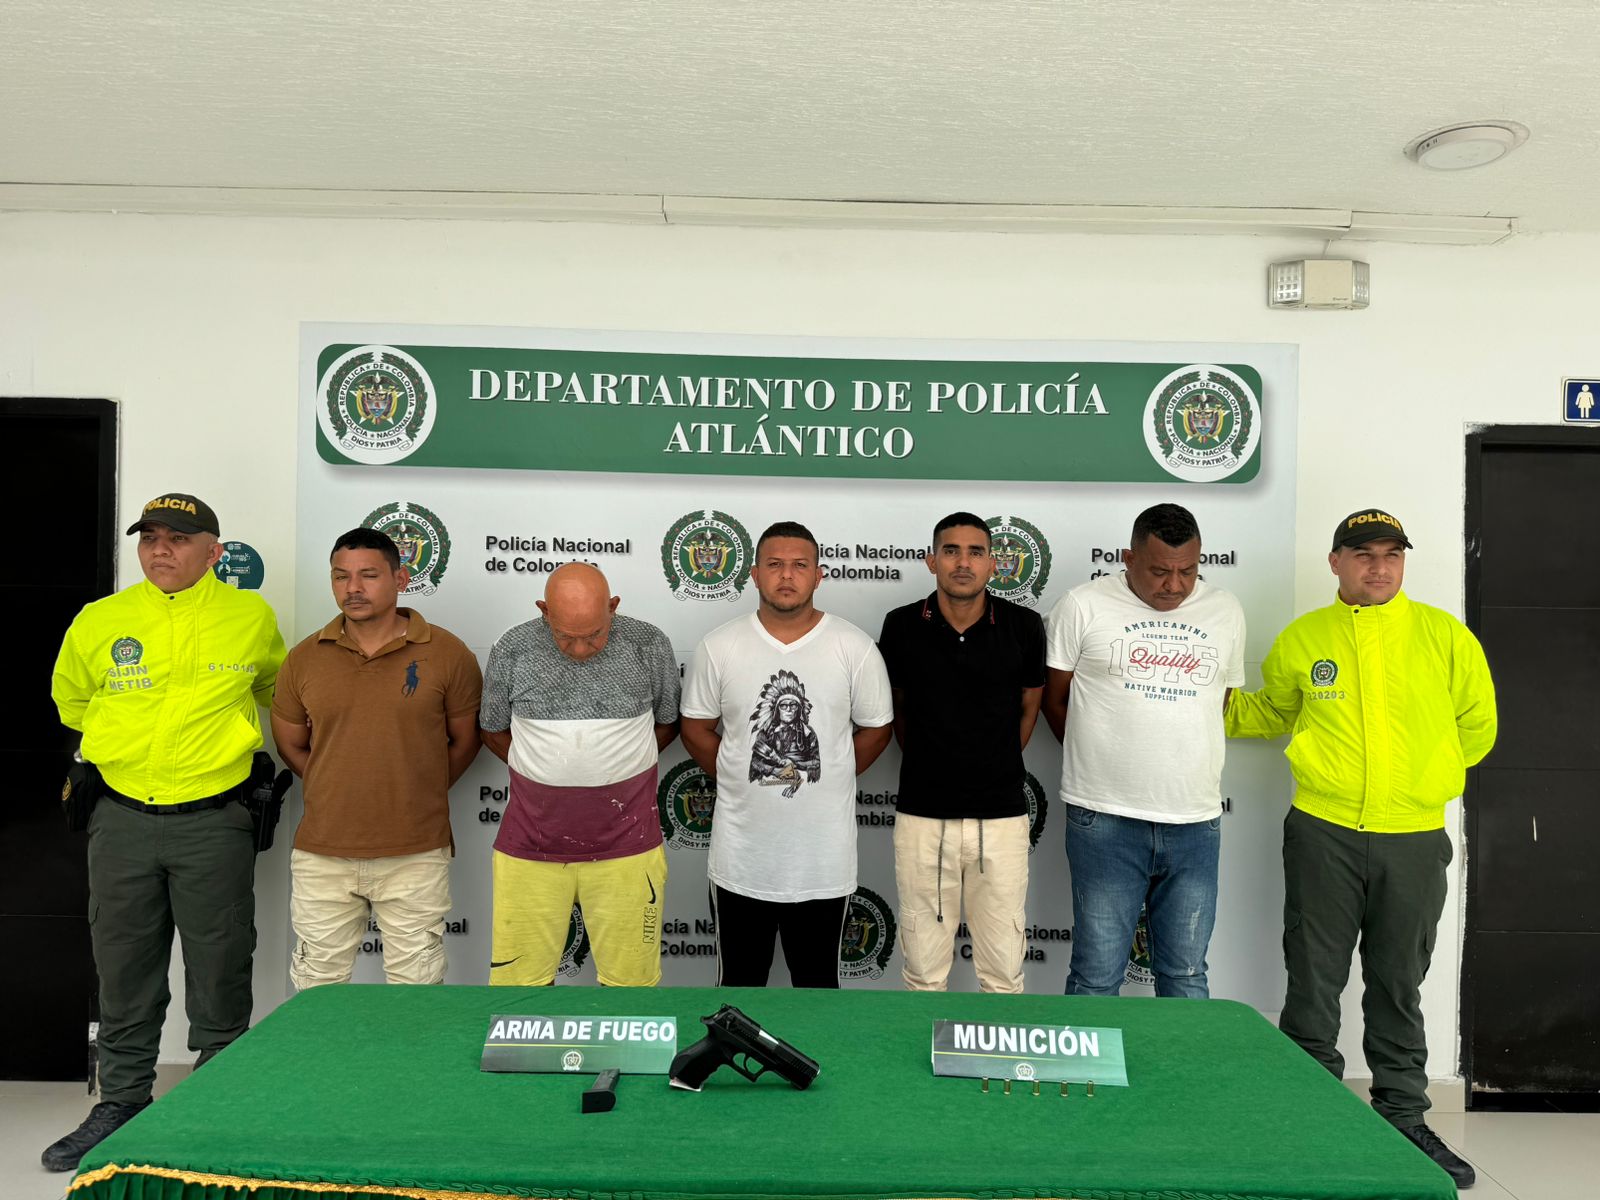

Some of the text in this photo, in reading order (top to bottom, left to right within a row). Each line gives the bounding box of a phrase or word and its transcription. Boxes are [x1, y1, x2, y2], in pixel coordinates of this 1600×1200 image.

[340, 366, 366, 406] REPUBLICA
[391, 368, 415, 407] COLOMBIA
[468, 369, 1110, 415] DEPARTAMENTO DE POLICÍA
[1166, 385, 1192, 425] REPUBLICA
[1217, 387, 1240, 426] COLOMBIA
[343, 414, 412, 439] POLICIA NACIONAL
[663, 413, 914, 458] ATLÁNTICO
[376, 437, 402, 448] PATRIA
[1170, 433, 1237, 456] POLICIA NACIONAL
[1202, 455, 1228, 466] PATRIA
[1348, 512, 1401, 531] POLICIA
[416, 517, 439, 555] COLOMBIA
[485, 535, 630, 554] Policía Nacional
[673, 523, 697, 561] REPUBLICA
[721, 525, 743, 561] COLOMBIA
[1019, 530, 1040, 568] COLOMBIA
[485, 557, 507, 572] de
[405, 583, 426, 593] ATRIA
[677, 568, 739, 591] POLICIA NACIONAL
[1004, 575, 1037, 597] NACIONAL
[706, 588, 732, 600] PATRIA
[1124, 621, 1208, 640] AMERICANINO
[1108, 638, 1220, 686] 1975
[1129, 647, 1200, 674] Quality
[1124, 682, 1197, 697] NATIVE WARRIOR
[1144, 692, 1177, 702] SUPPLIES
[479, 808, 500, 822] de
[671, 817, 694, 838] POLICIA
[642, 906, 658, 944] NIKE
[864, 900, 886, 938] COLOMBIA
[850, 946, 882, 968] NACIONAL
[849, 966, 874, 977] PATRIA
[490, 1020, 676, 1042] ARMA DE FUEGO
[954, 1024, 1100, 1057] MUNICIÓN
